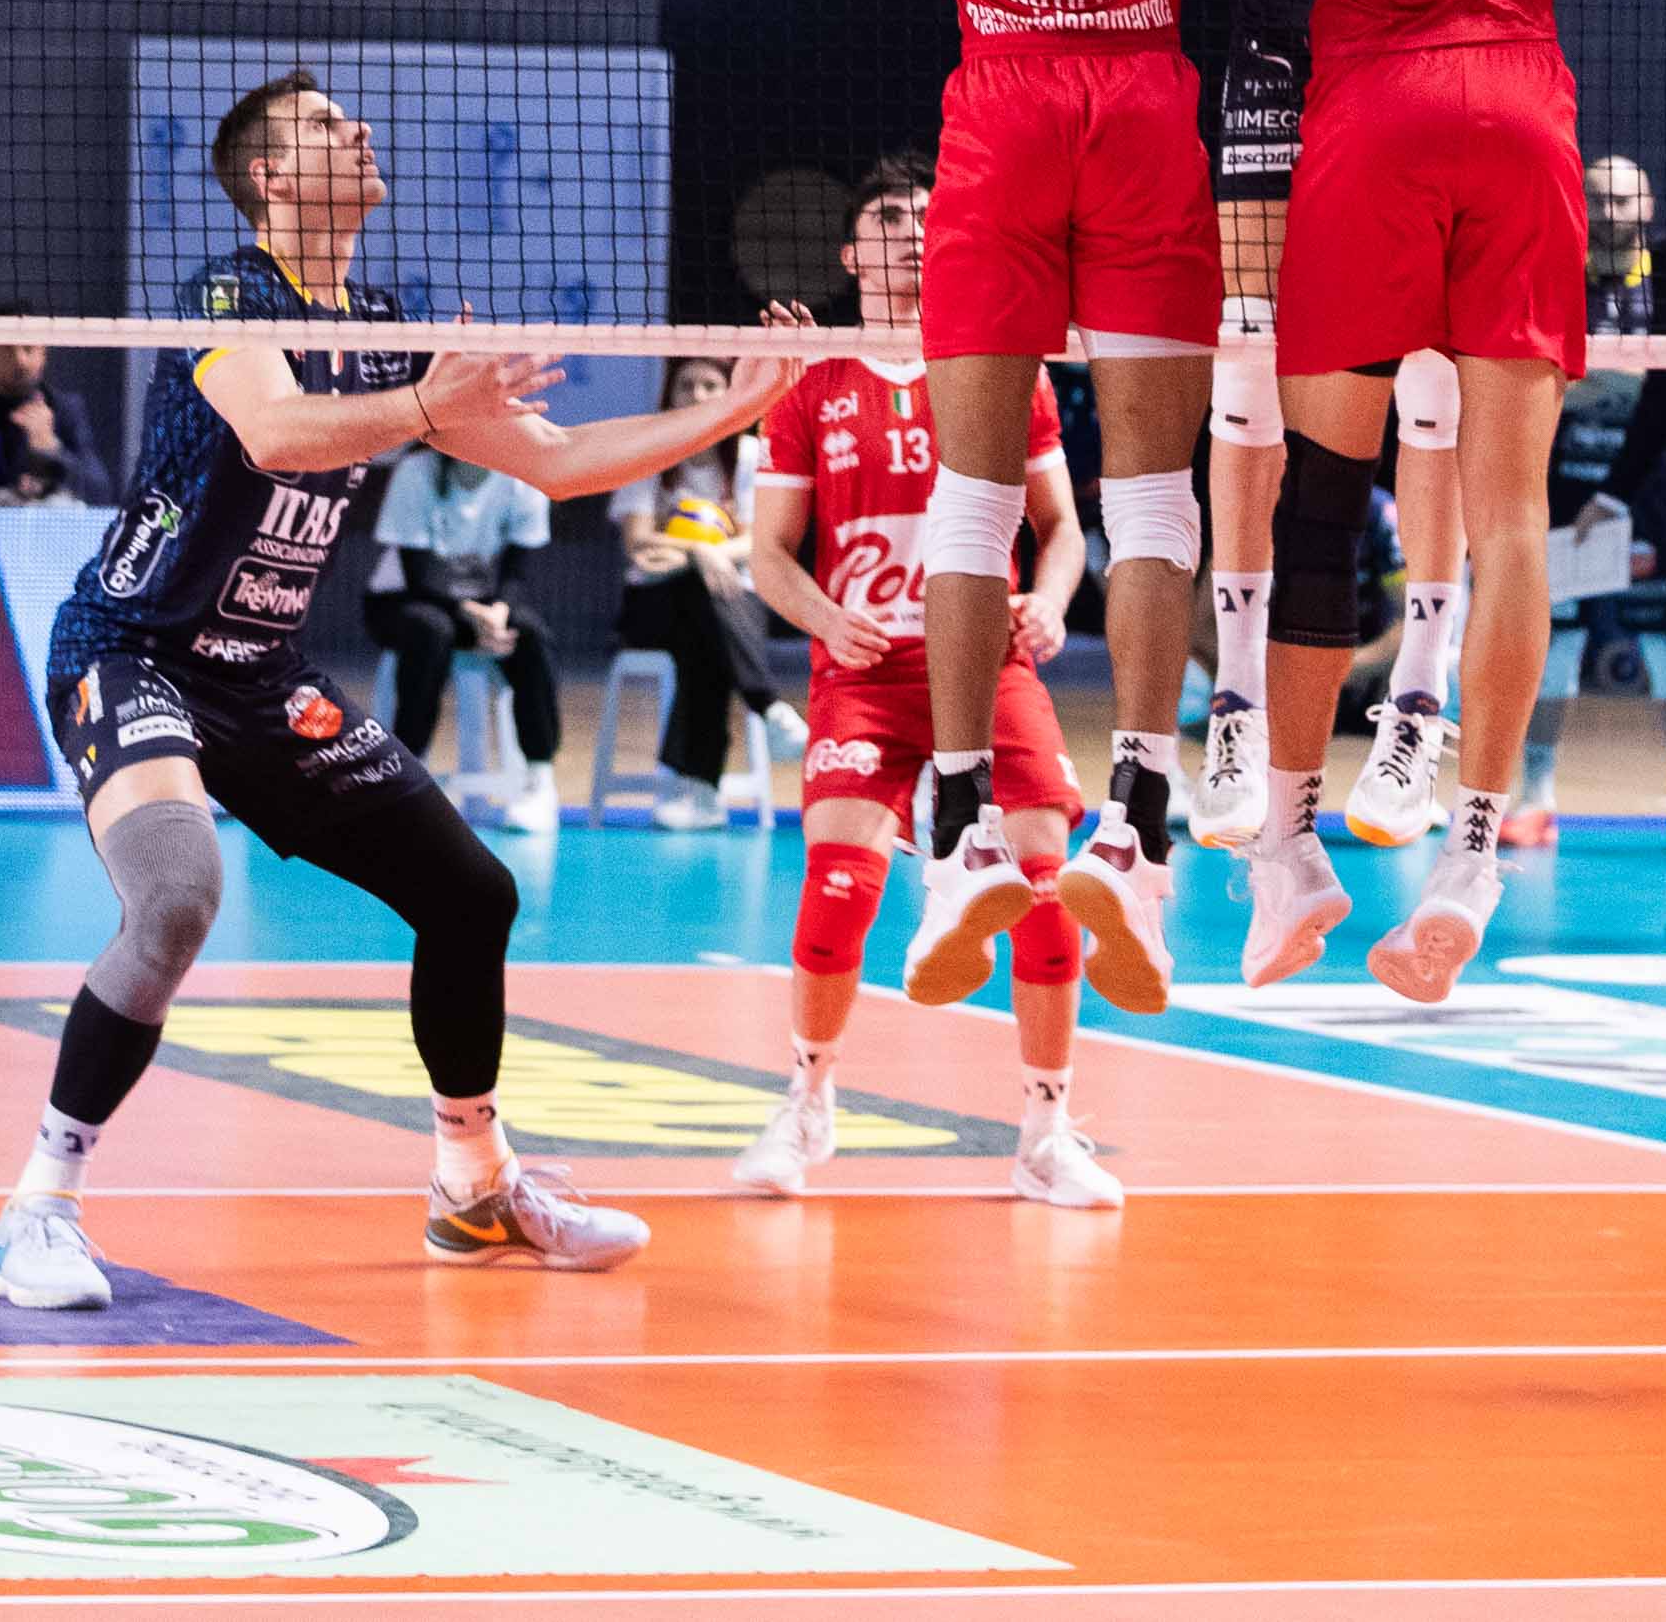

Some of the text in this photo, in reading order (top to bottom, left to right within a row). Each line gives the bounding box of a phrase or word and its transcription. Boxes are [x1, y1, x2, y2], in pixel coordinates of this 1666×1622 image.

[885, 426, 932, 475] 13
[108, 495, 167, 592] Melinda
[256, 482, 351, 547] ITAS
